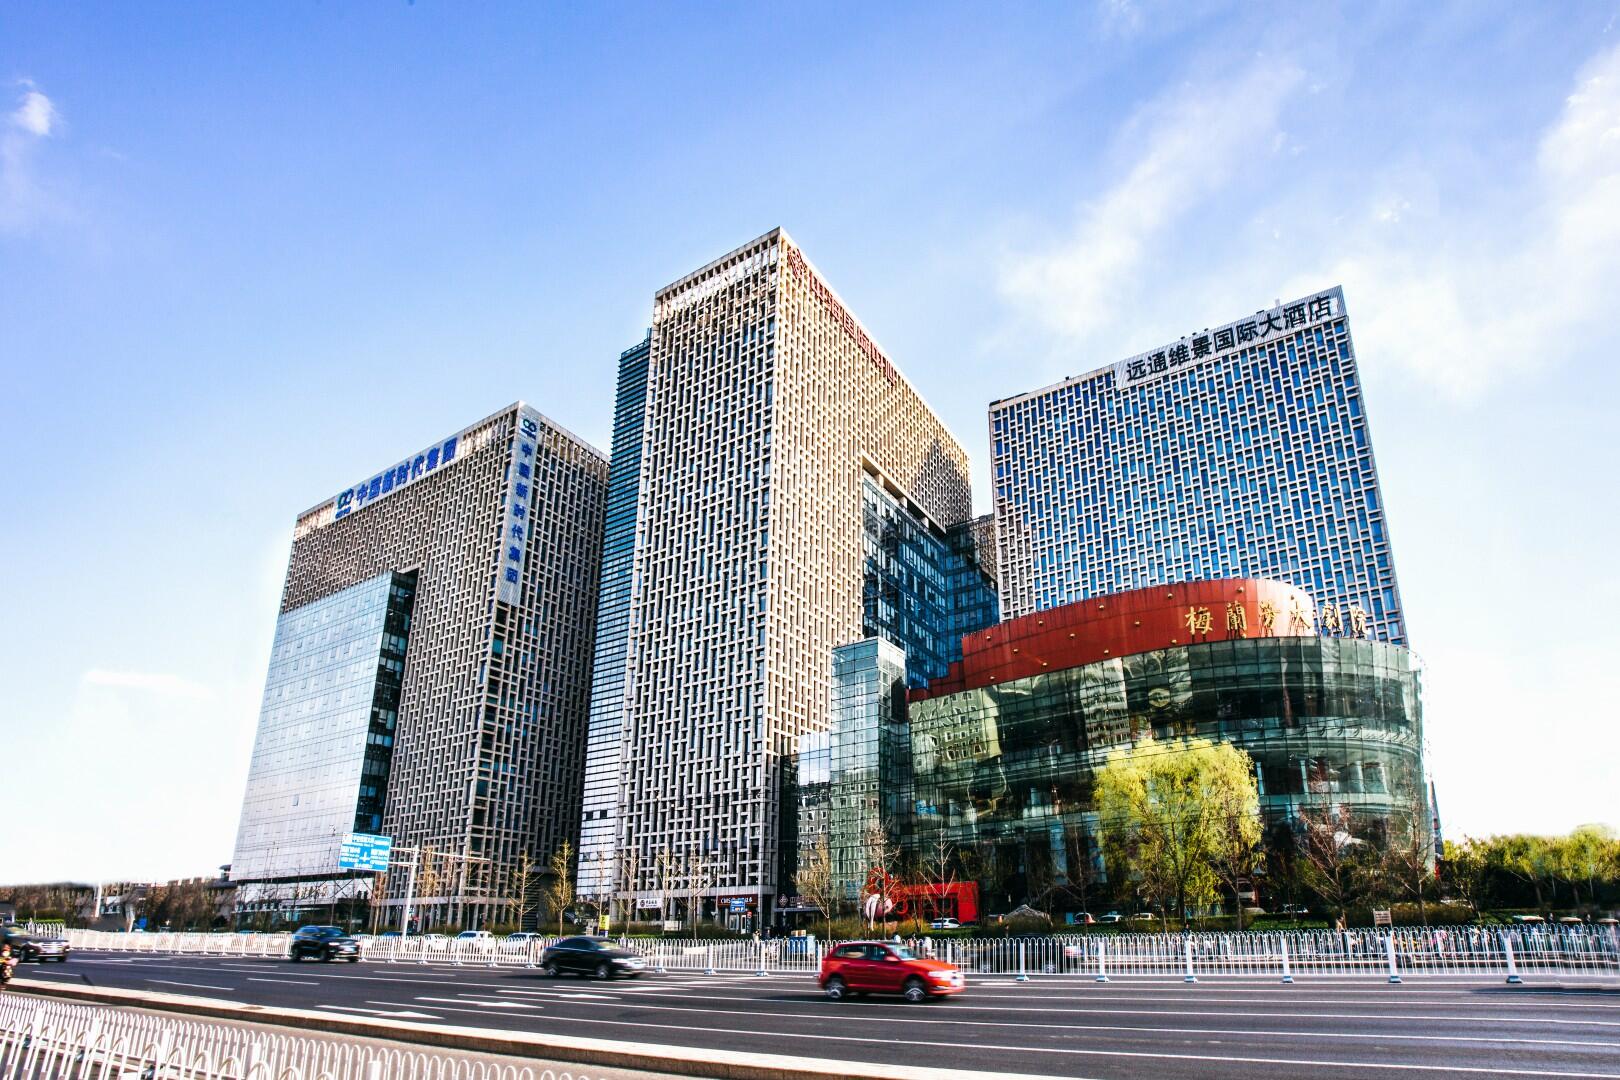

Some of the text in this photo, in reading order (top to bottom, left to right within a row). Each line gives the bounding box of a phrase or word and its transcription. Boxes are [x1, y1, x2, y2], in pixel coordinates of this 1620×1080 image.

[1126, 296, 1332, 382] 远通维景国际大酒店
[357, 437, 457, 506] 中国新时代集团
[506, 443, 533, 584] 中国新时代集团
